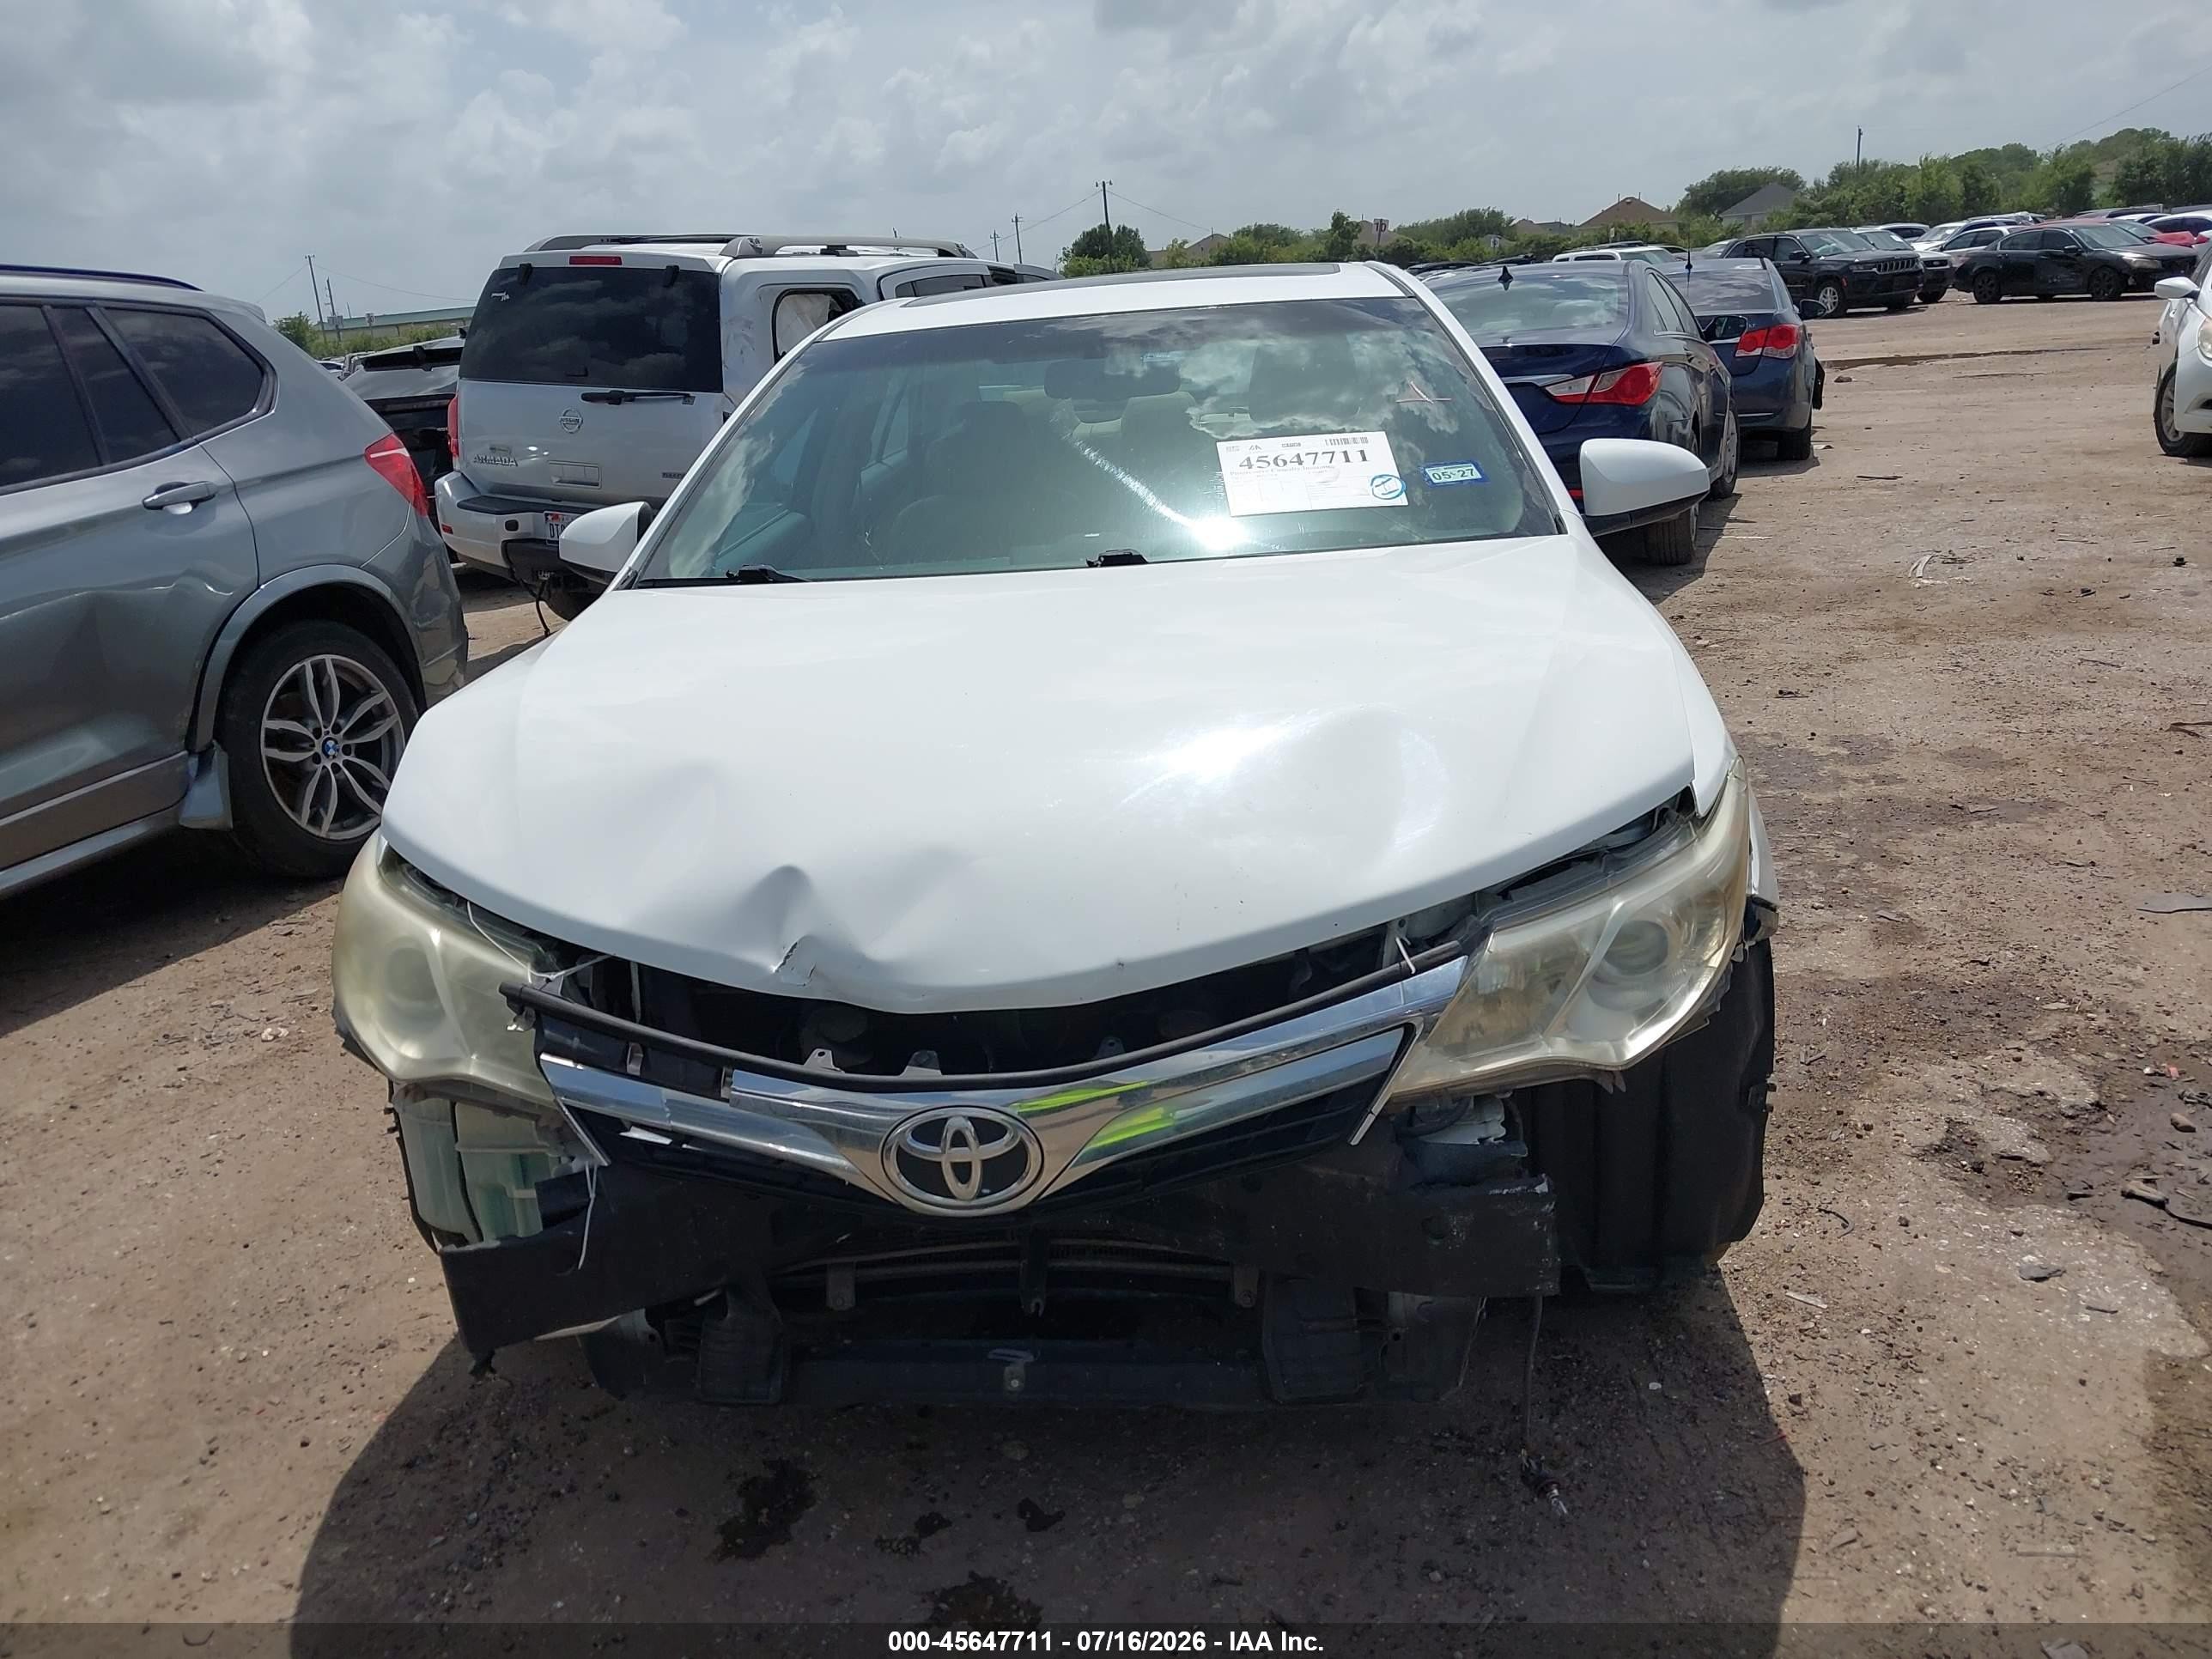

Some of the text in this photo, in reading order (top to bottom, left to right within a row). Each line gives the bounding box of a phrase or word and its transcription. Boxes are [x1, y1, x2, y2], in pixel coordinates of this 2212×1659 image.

[473, 454, 518, 466] ARMADA
[1239, 449, 1370, 470] 45647711
[1431, 468, 1474, 481] 05 27
